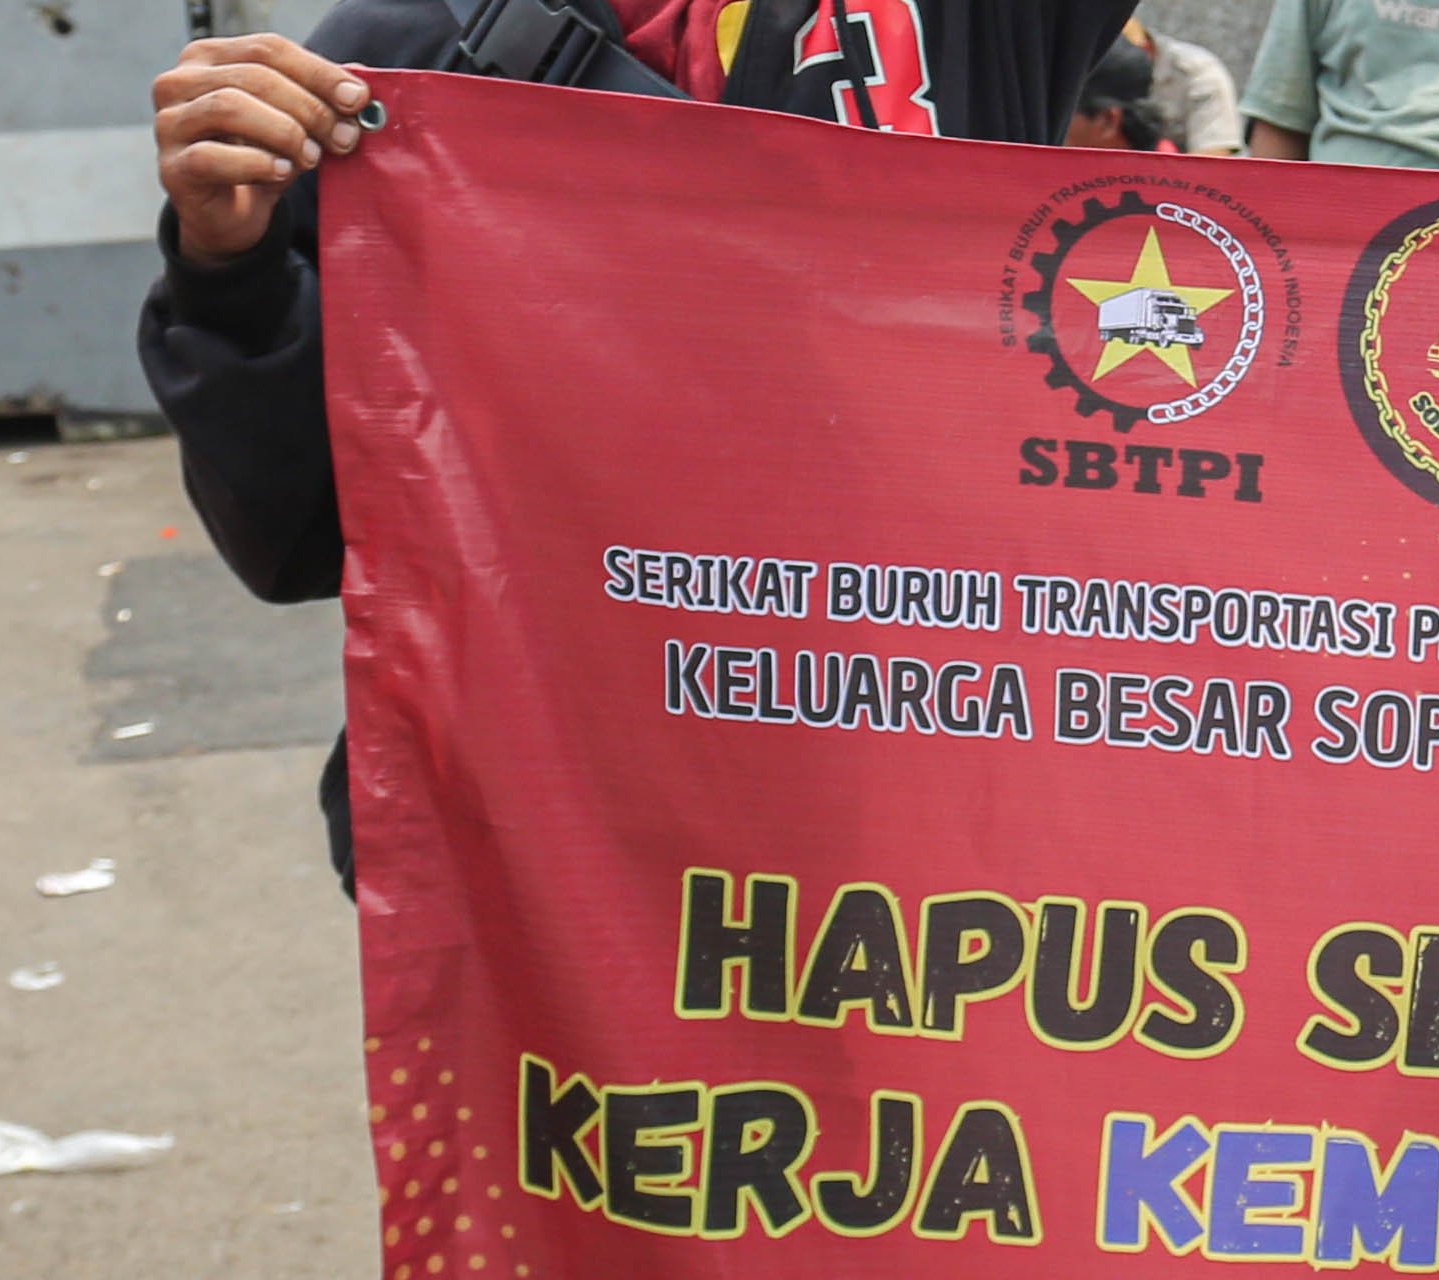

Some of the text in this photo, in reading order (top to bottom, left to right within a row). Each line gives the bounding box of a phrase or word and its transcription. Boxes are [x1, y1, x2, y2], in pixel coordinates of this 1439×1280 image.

[998, 265, 1018, 348] SERIKAT
[1009, 202, 1054, 262] BURUH
[1048, 174, 1191, 204] TRANSPORTASI
[1194, 182, 1294, 272] PERJUANGAN
[1018, 436, 1264, 504] SBTPI
[604, 546, 818, 619] SERIKAT
[827, 562, 1001, 631] BURUH
[1013, 575, 1397, 657] TRANSPORTASI
[663, 638, 1032, 741] KELUARGA
[1053, 667, 1293, 762] BESAR
[673, 866, 1249, 1060] HAPUS
[518, 1052, 1044, 1246] KERJA
